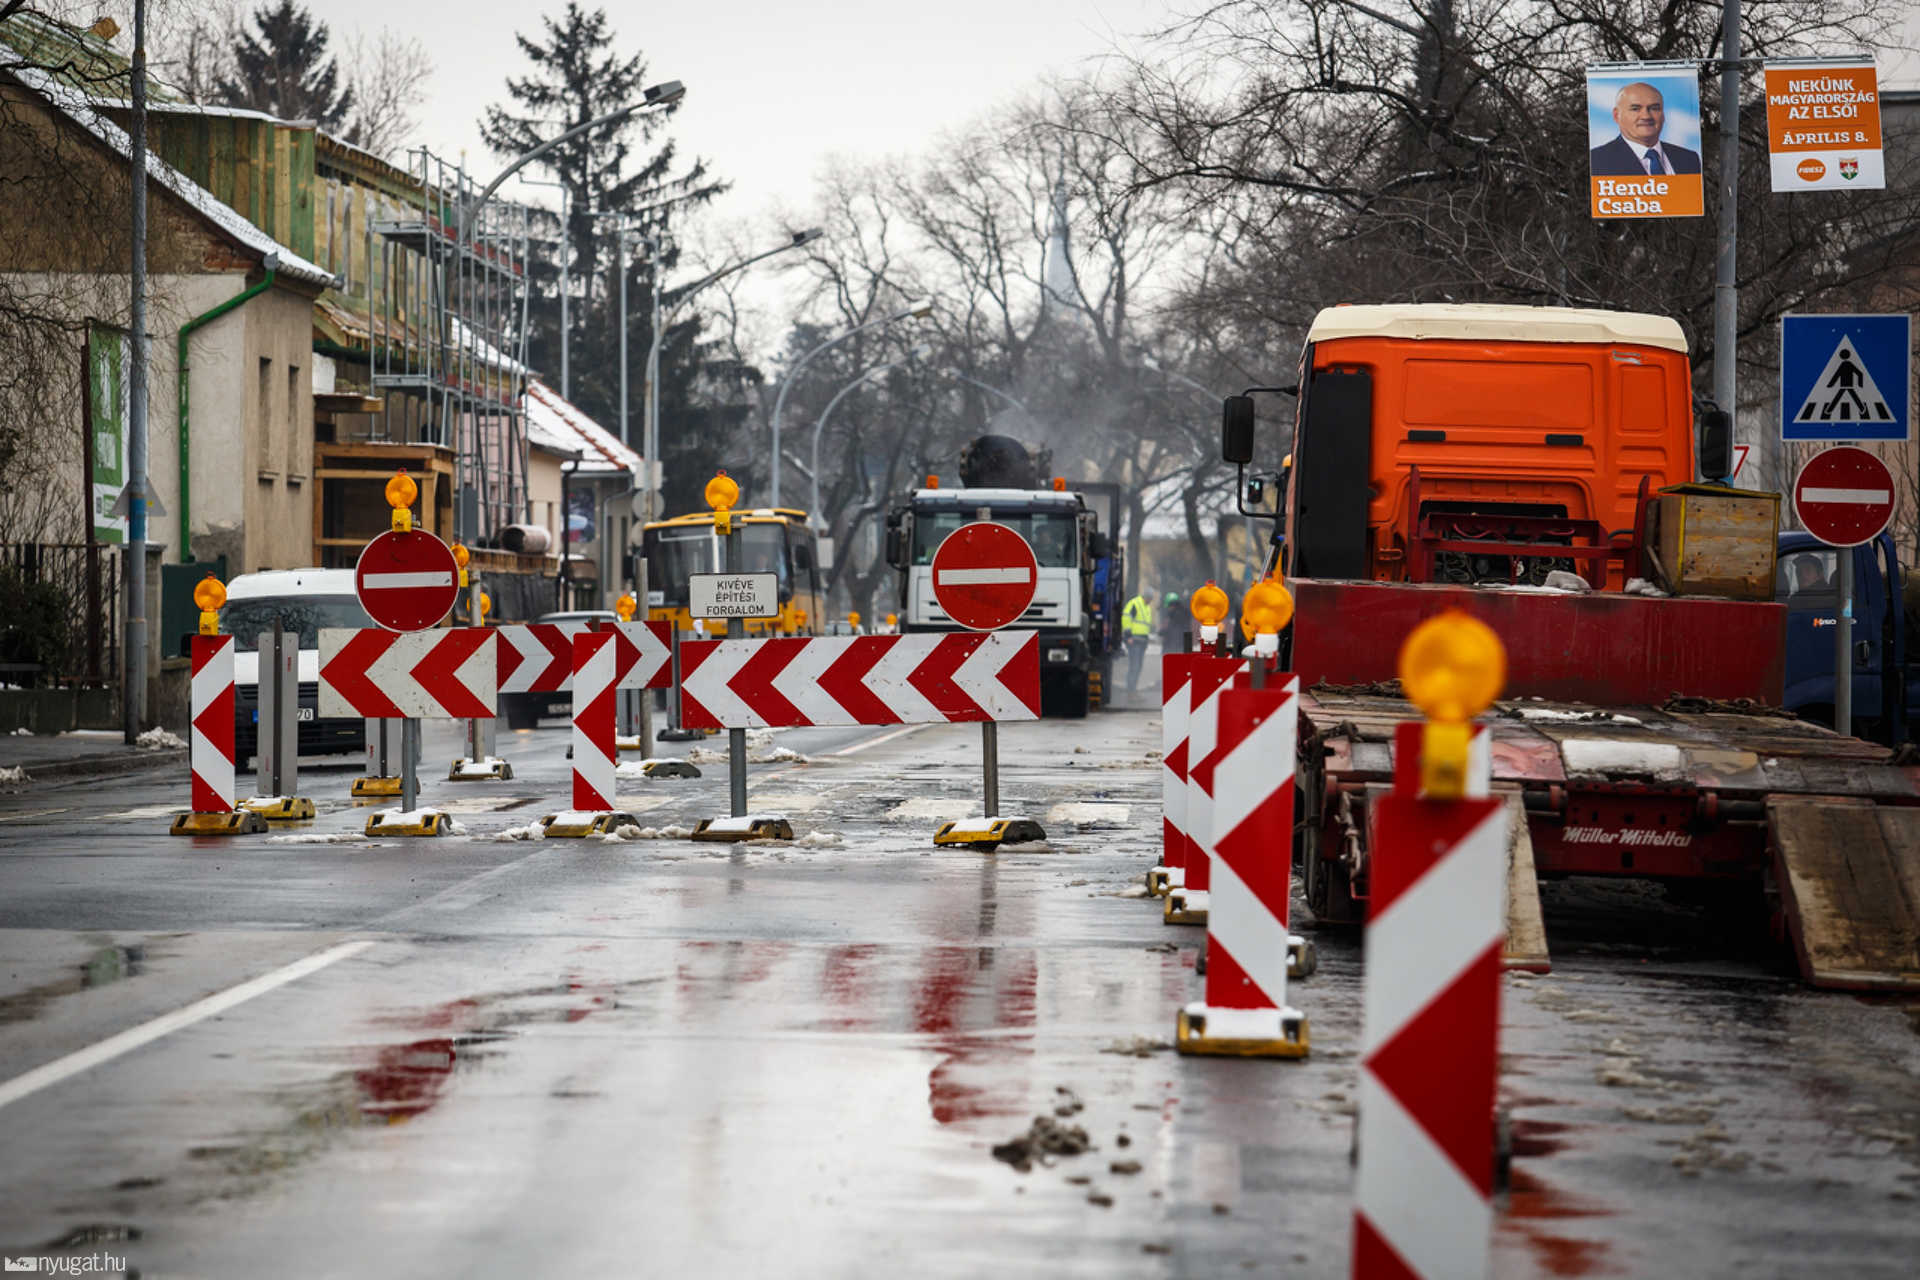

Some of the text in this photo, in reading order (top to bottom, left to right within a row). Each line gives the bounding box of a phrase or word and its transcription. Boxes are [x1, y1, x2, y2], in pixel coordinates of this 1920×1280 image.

[1788, 76, 1855, 93] NEKÜNK
[1769, 90, 1875, 106] MAGYARORSZÁG
[1788, 102, 1858, 120] AZ ELSŐ!
[1782, 131, 1869, 145] ÁPRILIS 8.
[1597, 178, 1669, 196] Hende
[1597, 197, 1663, 214] Csaba
[717, 578, 754, 590] KIVÉVE
[715, 591, 756, 602] ÉPÍTÉSI
[706, 605, 765, 615] FORGALOM
[1562, 826, 1619, 844] Müller
